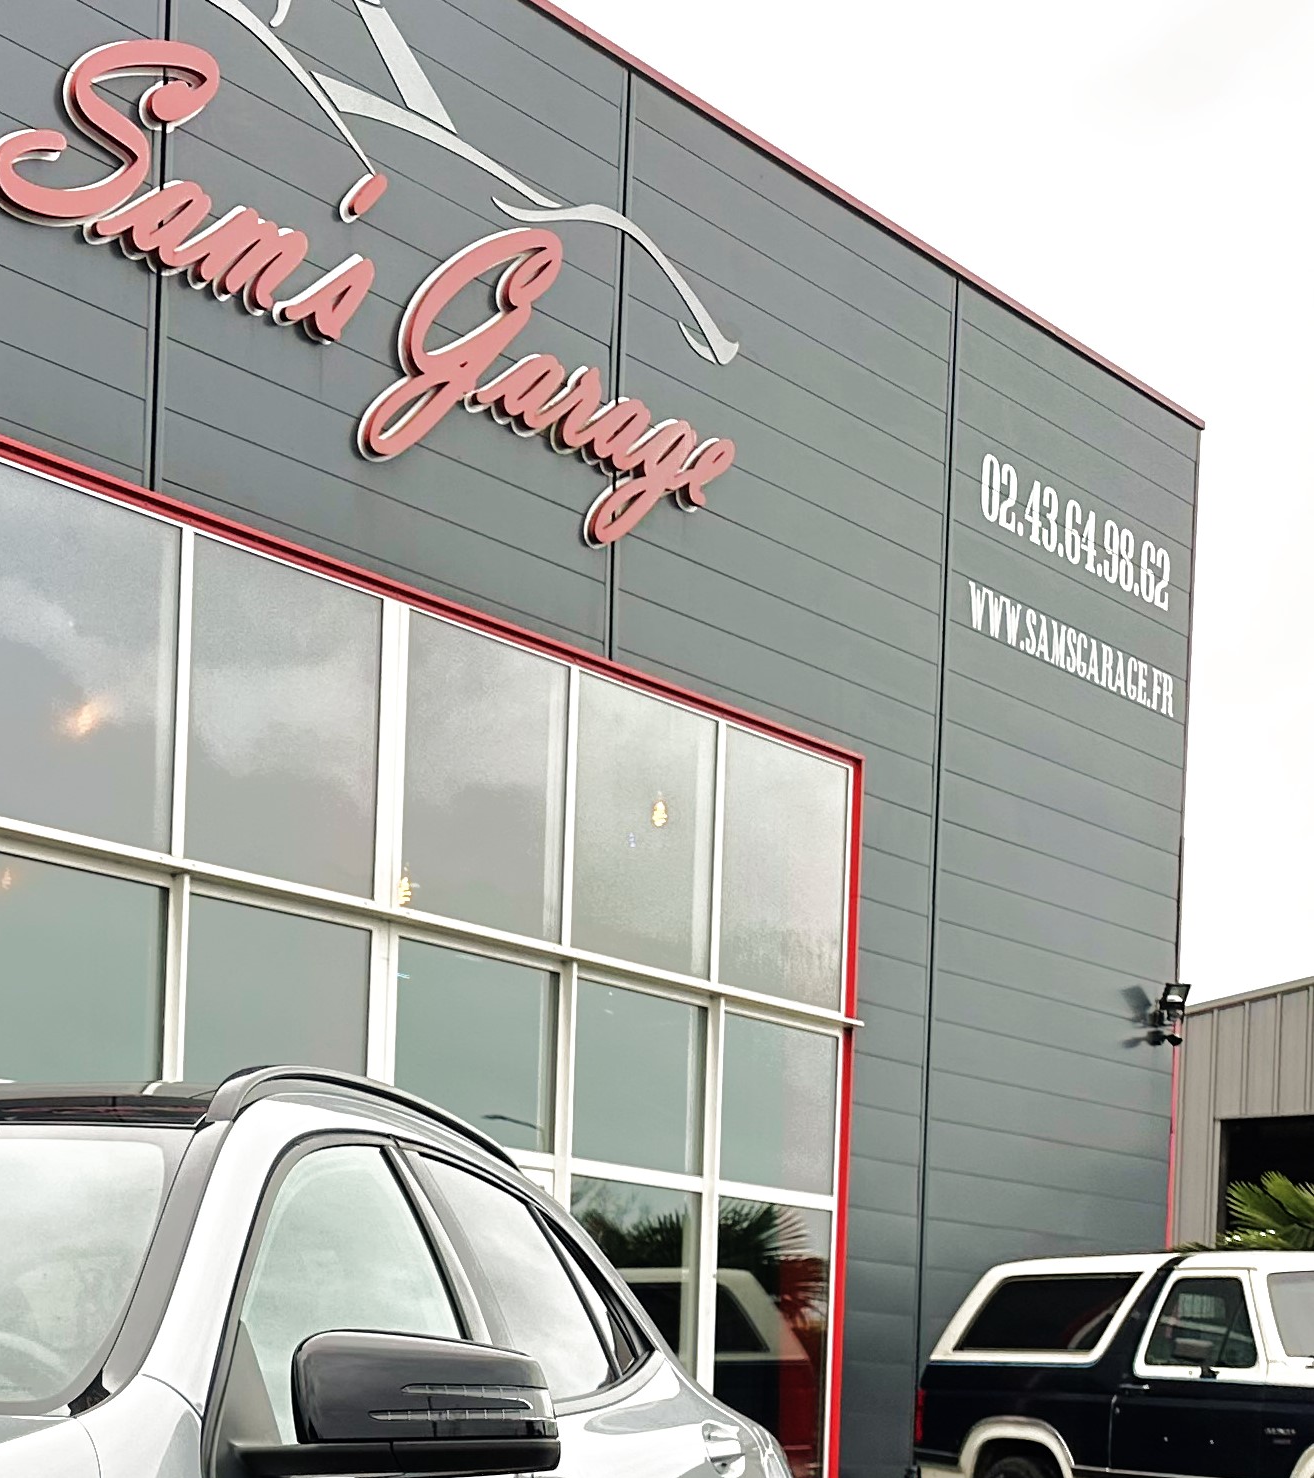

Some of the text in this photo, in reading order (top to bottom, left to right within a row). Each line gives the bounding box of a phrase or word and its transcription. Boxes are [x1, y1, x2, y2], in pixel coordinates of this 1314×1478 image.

[356, 226, 736, 548] Garage
[980, 452, 1172, 612] 02.43.64.98.62
[968, 580, 1174, 718] WWW.SAMSGARAGE.FR
